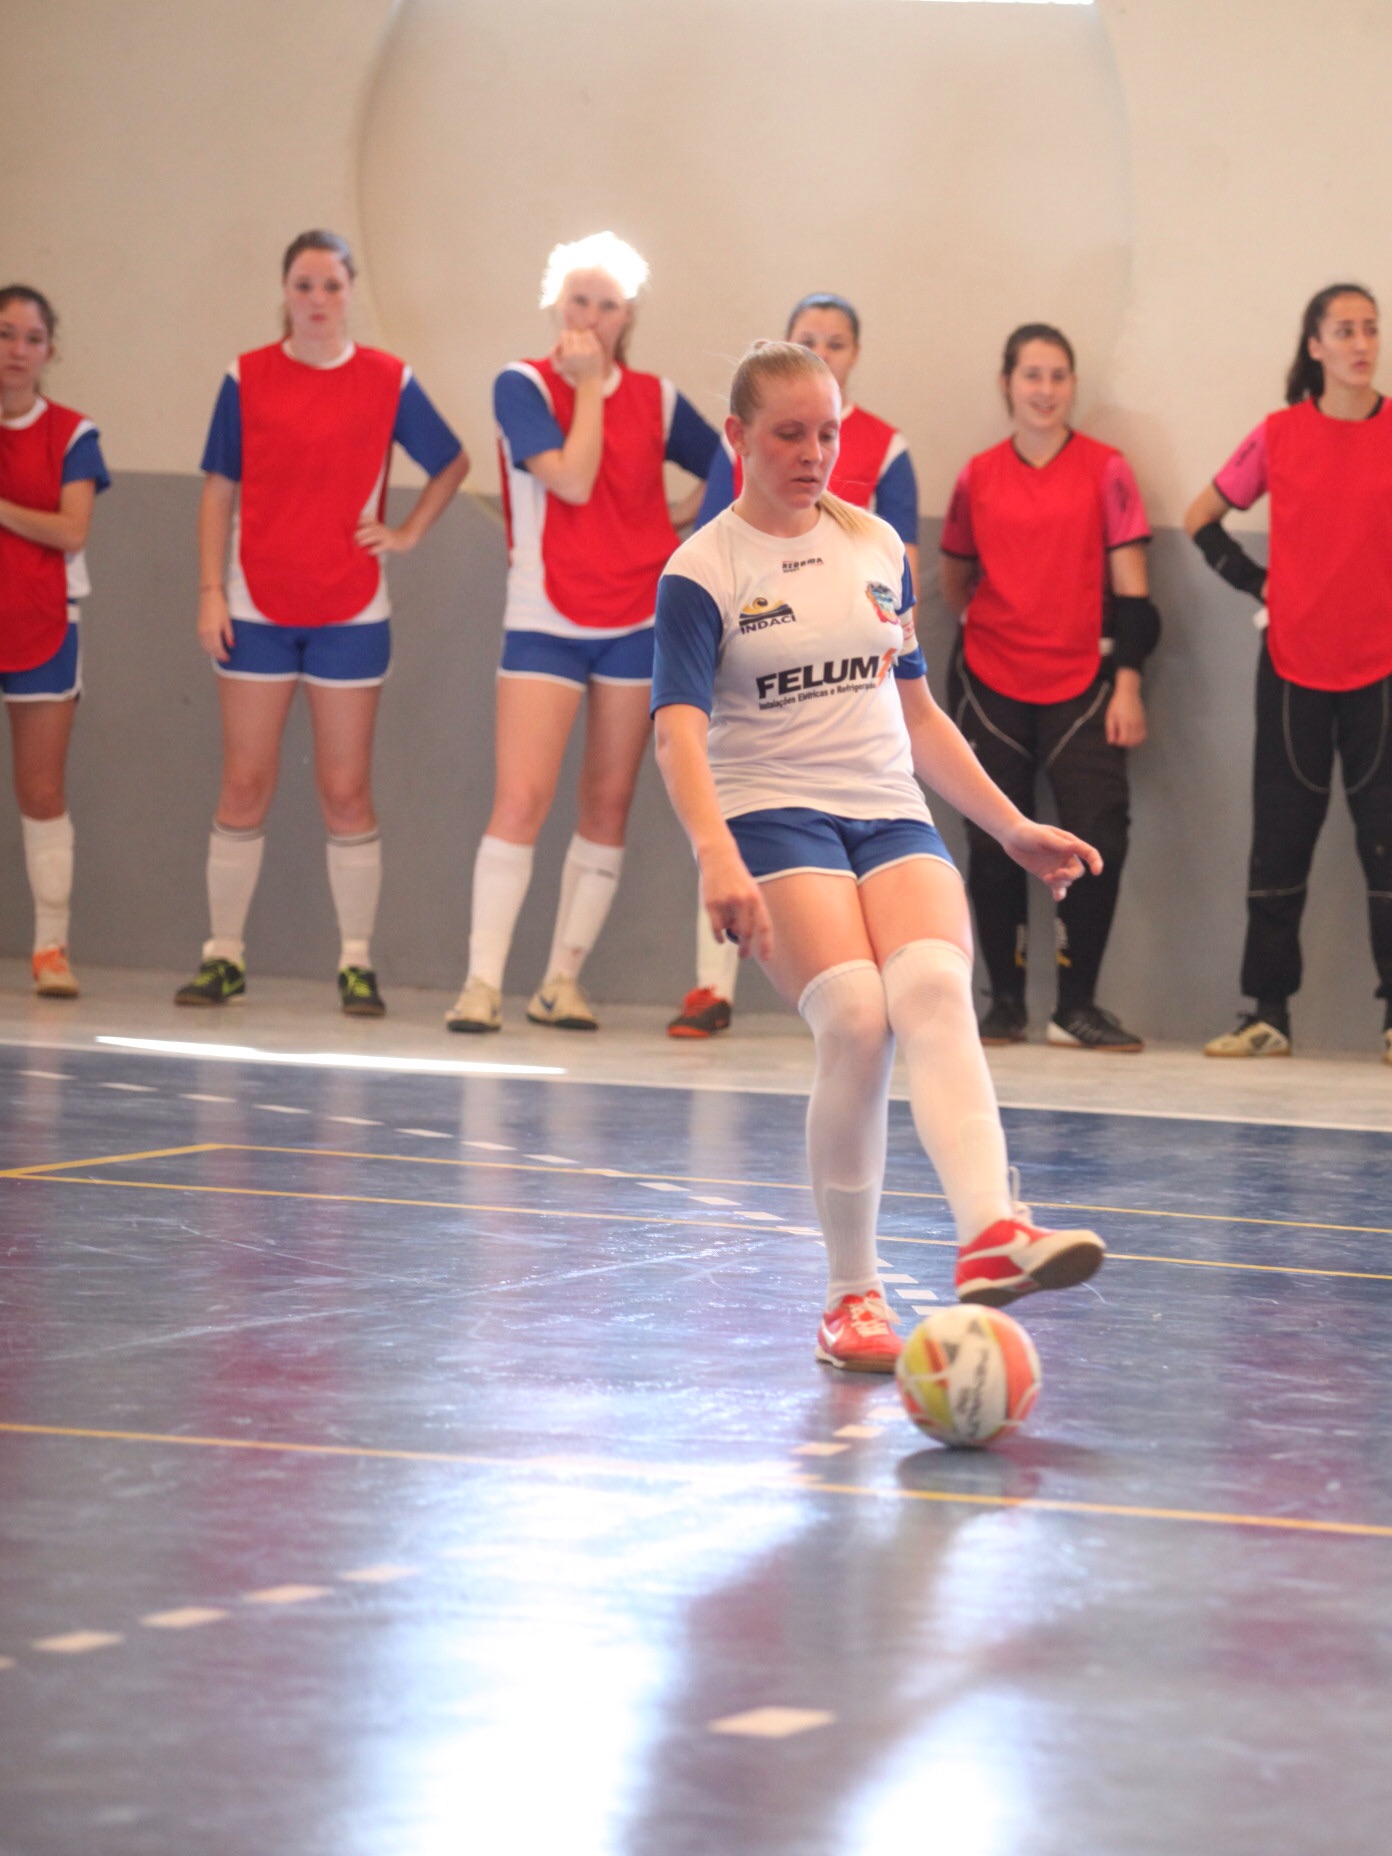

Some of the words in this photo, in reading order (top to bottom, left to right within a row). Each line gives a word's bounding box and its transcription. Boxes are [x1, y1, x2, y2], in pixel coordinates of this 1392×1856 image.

[740, 614, 796, 635] INDACI
[758, 696, 796, 711] Instalações
[798, 687, 828, 702] Elétricas
